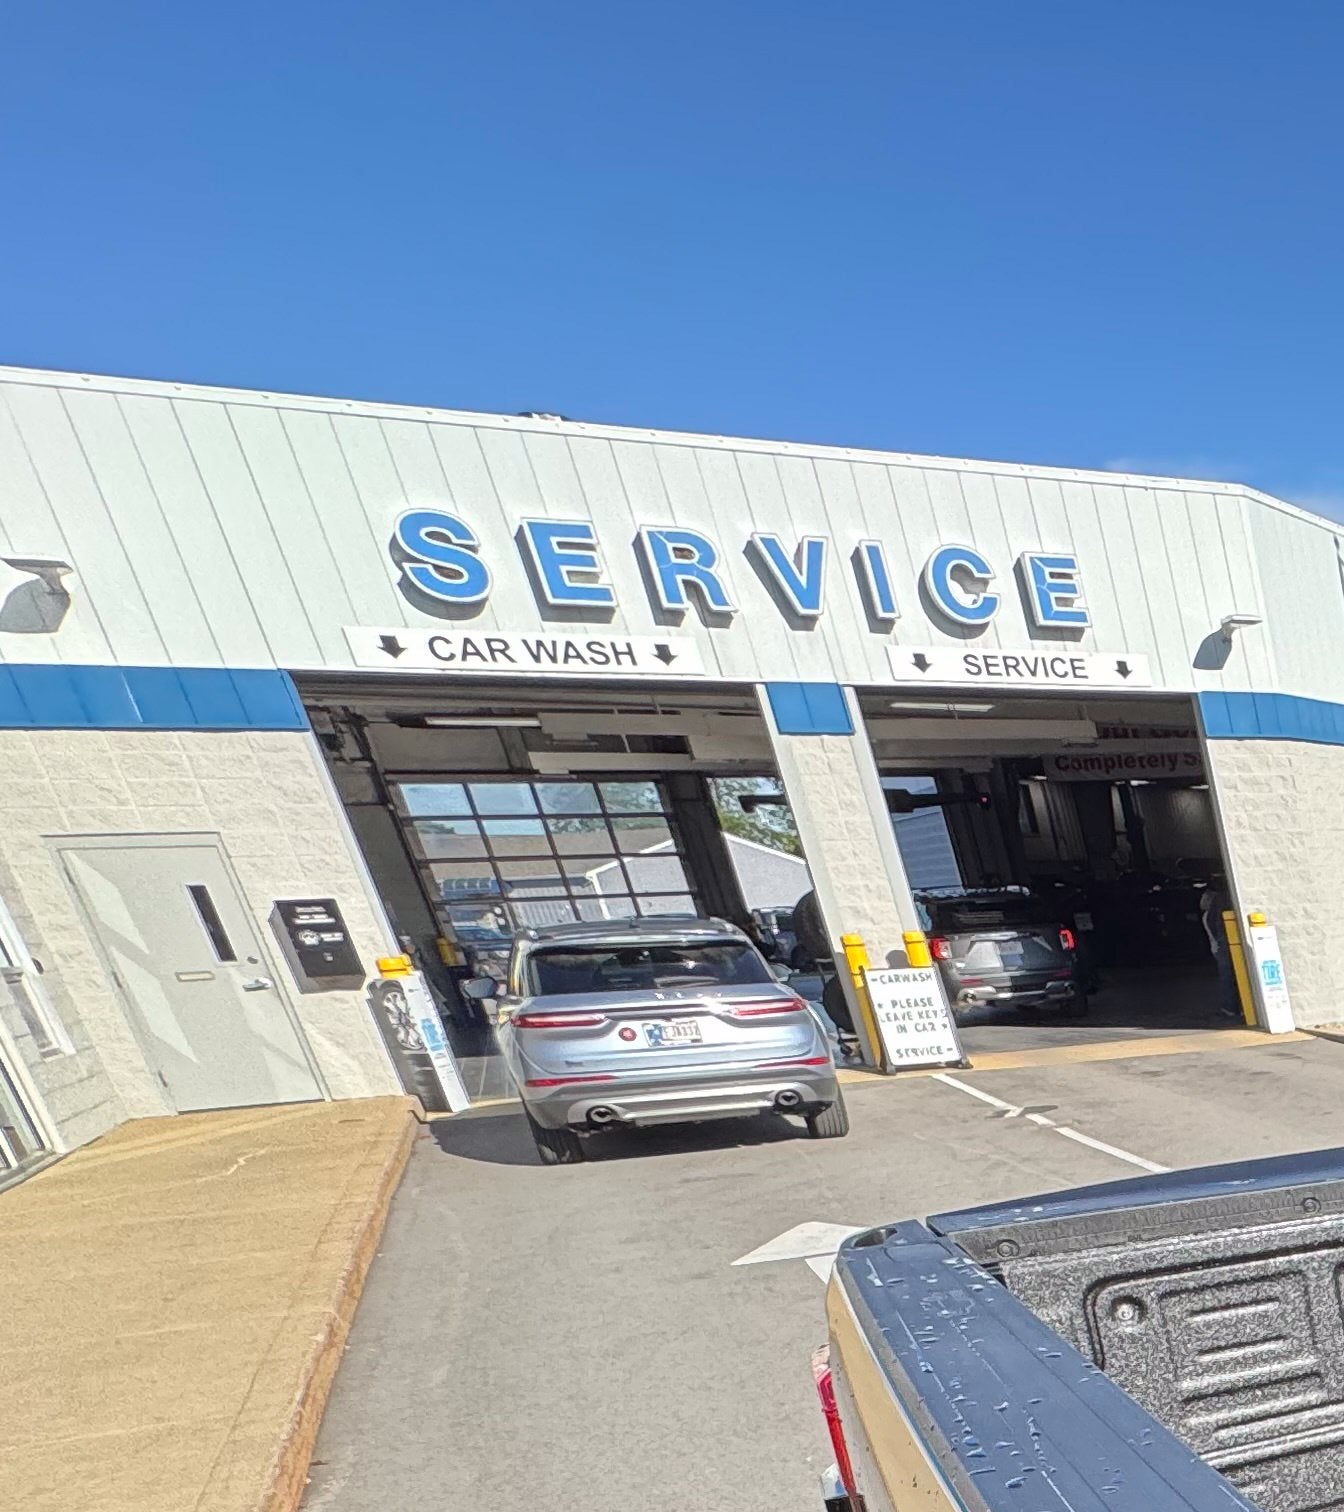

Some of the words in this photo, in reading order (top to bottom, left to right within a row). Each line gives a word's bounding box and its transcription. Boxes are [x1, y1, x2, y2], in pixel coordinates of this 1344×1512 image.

[393, 507, 1093, 634] SERVICE
[427, 635, 517, 664] CAR
[521, 638, 638, 667] WASH
[962, 653, 1089, 679] SERVICE
[1055, 753, 1178, 774] Completely
[879, 972, 933, 985] CARWASH
[890, 997, 934, 1009] PLEASE
[896, 1023, 908, 1034] IN
[914, 1021, 936, 1033] CAR
[895, 1045, 944, 1059] SERVICE
